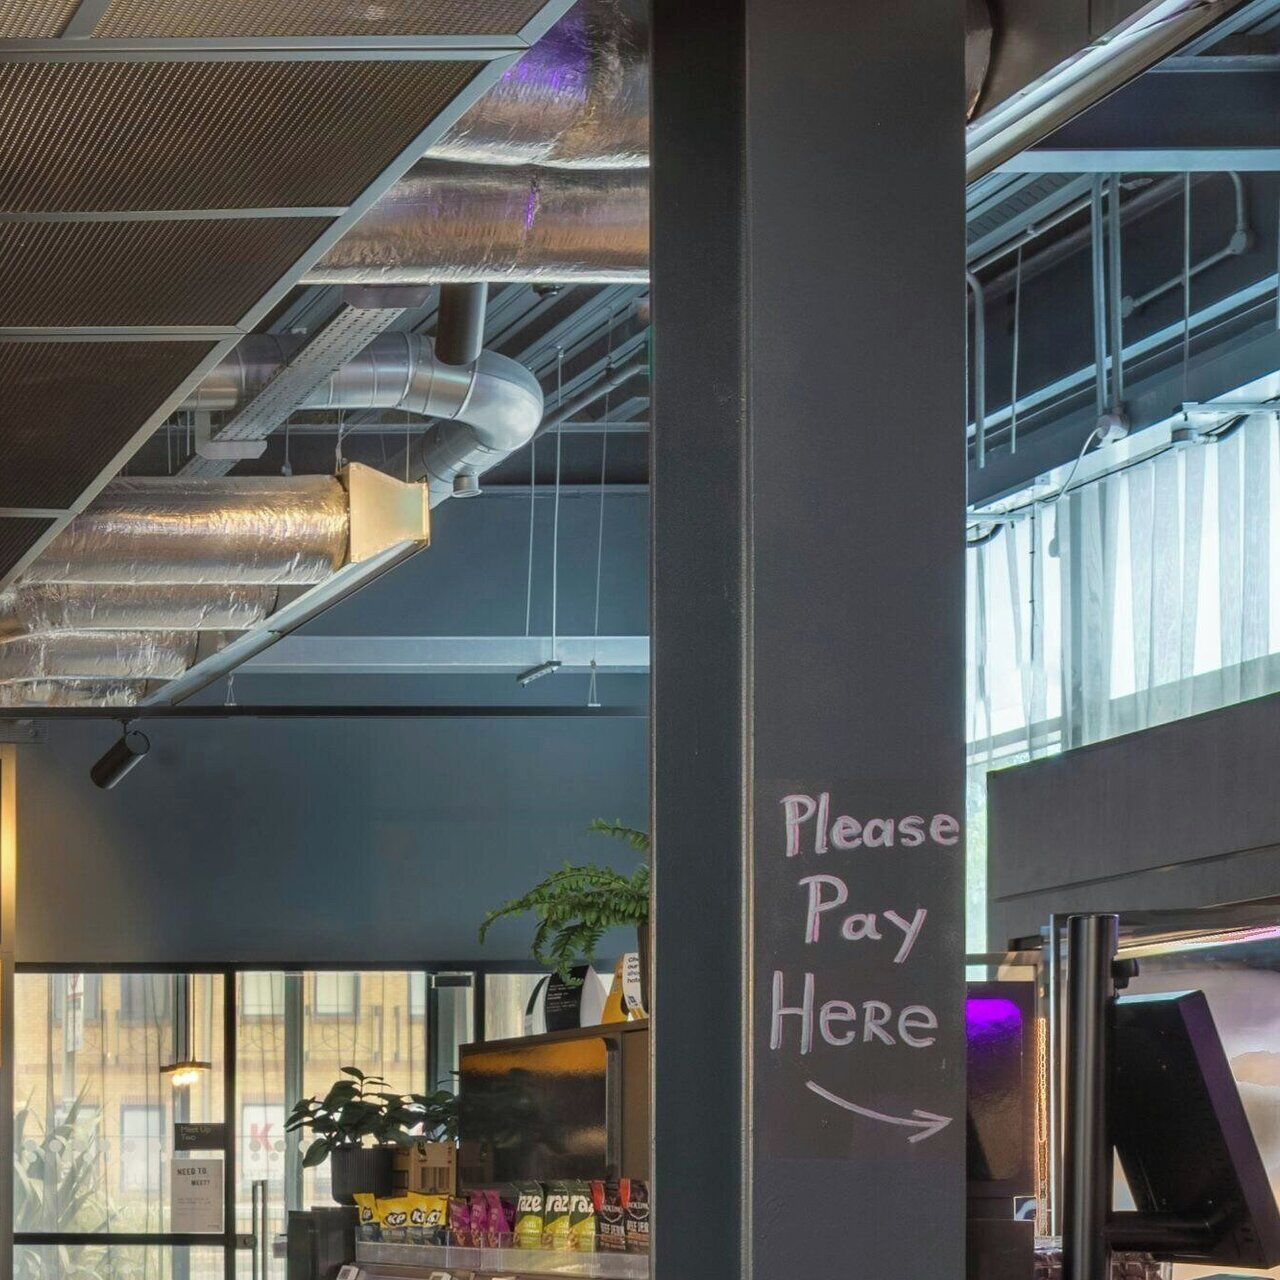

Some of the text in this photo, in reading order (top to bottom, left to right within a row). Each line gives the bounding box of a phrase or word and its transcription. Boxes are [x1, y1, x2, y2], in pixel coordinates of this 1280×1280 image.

[780, 791, 961, 857] Please
[798, 874, 928, 963] Pay
[176, 1167, 207, 1176] NEED TO
[517, 1194, 542, 1212] raze
[545, 1194, 569, 1214] raz
